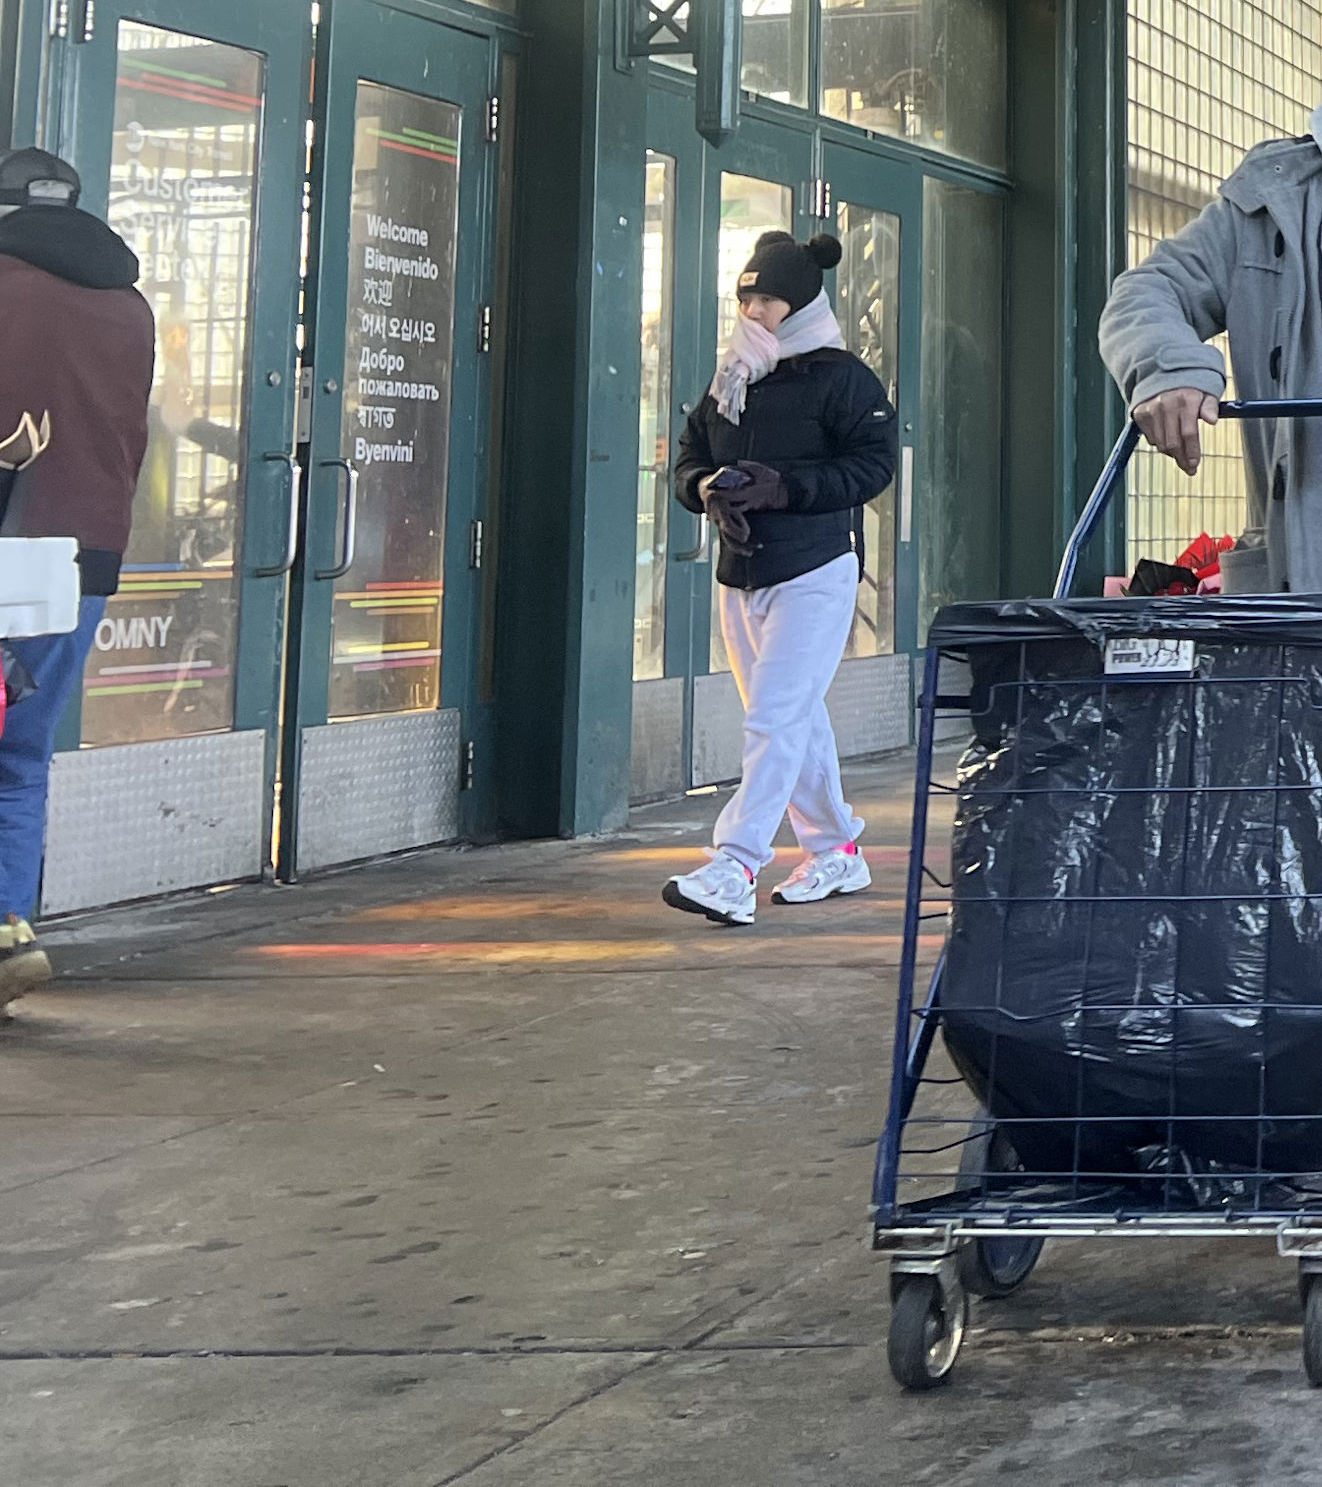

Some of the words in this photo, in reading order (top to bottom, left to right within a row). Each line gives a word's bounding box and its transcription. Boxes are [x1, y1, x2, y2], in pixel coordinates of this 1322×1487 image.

[366, 213, 429, 247] Welcome
[364, 246, 439, 281] Bienvenido
[363, 277, 393, 307] 欢迎
[360, 313, 387, 341] 어서
[388, 317, 436, 344] 오십시오
[359, 346, 405, 376] Добро
[358, 378, 440, 401] пожаловать
[355, 436, 414, 465] Byenvini
[94, 615, 173, 651] OMNY
